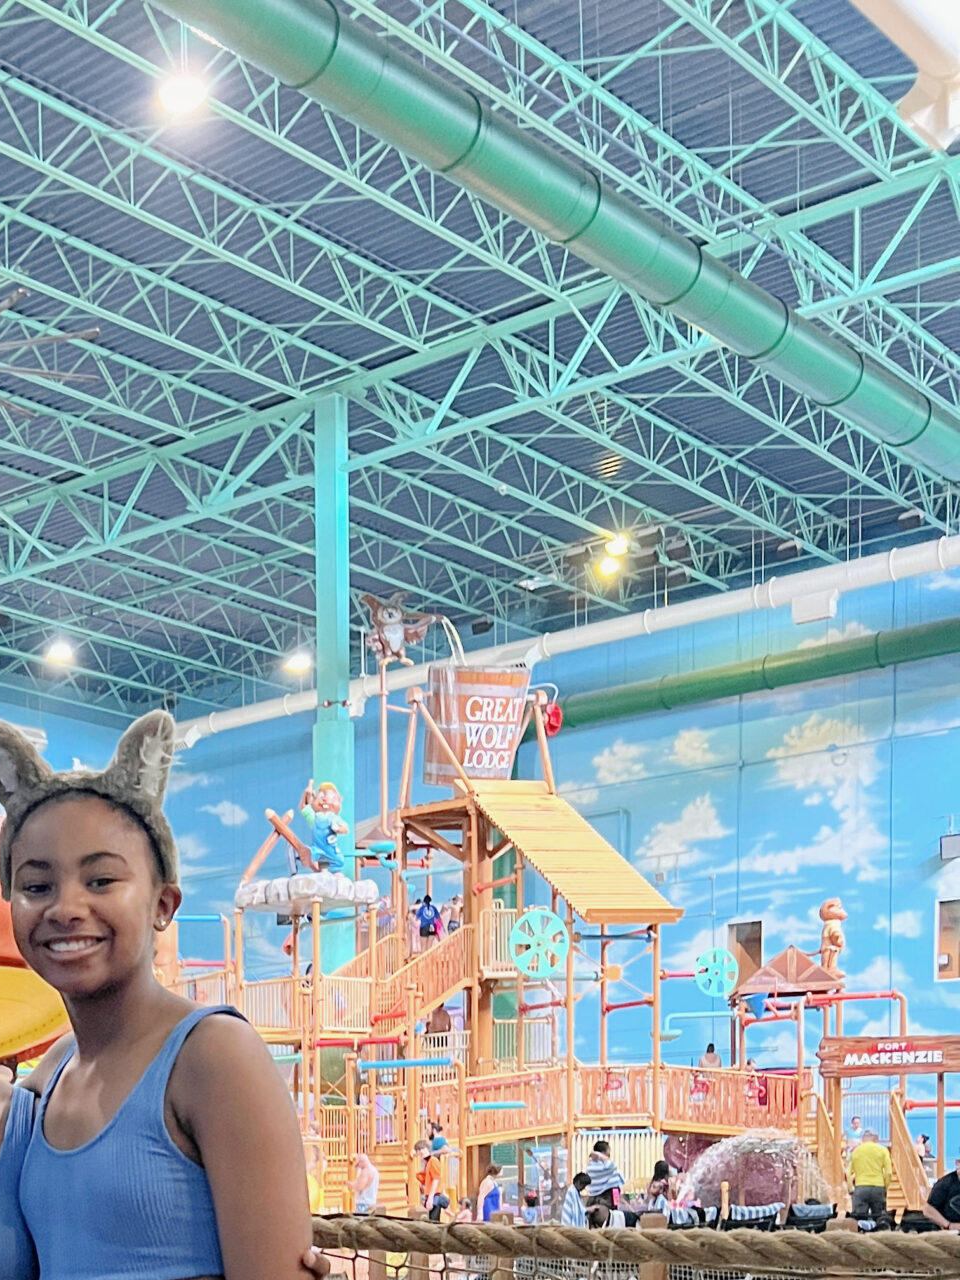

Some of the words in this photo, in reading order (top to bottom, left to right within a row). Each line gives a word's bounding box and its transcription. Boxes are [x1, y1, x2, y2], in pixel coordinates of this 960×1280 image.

[465, 696, 523, 722] GREAT
[464, 722, 515, 749] WOLF
[462, 749, 511, 769] LODGE
[877, 1042, 907, 1051] FORT
[843, 1050, 943, 1066] MACKENZIE
